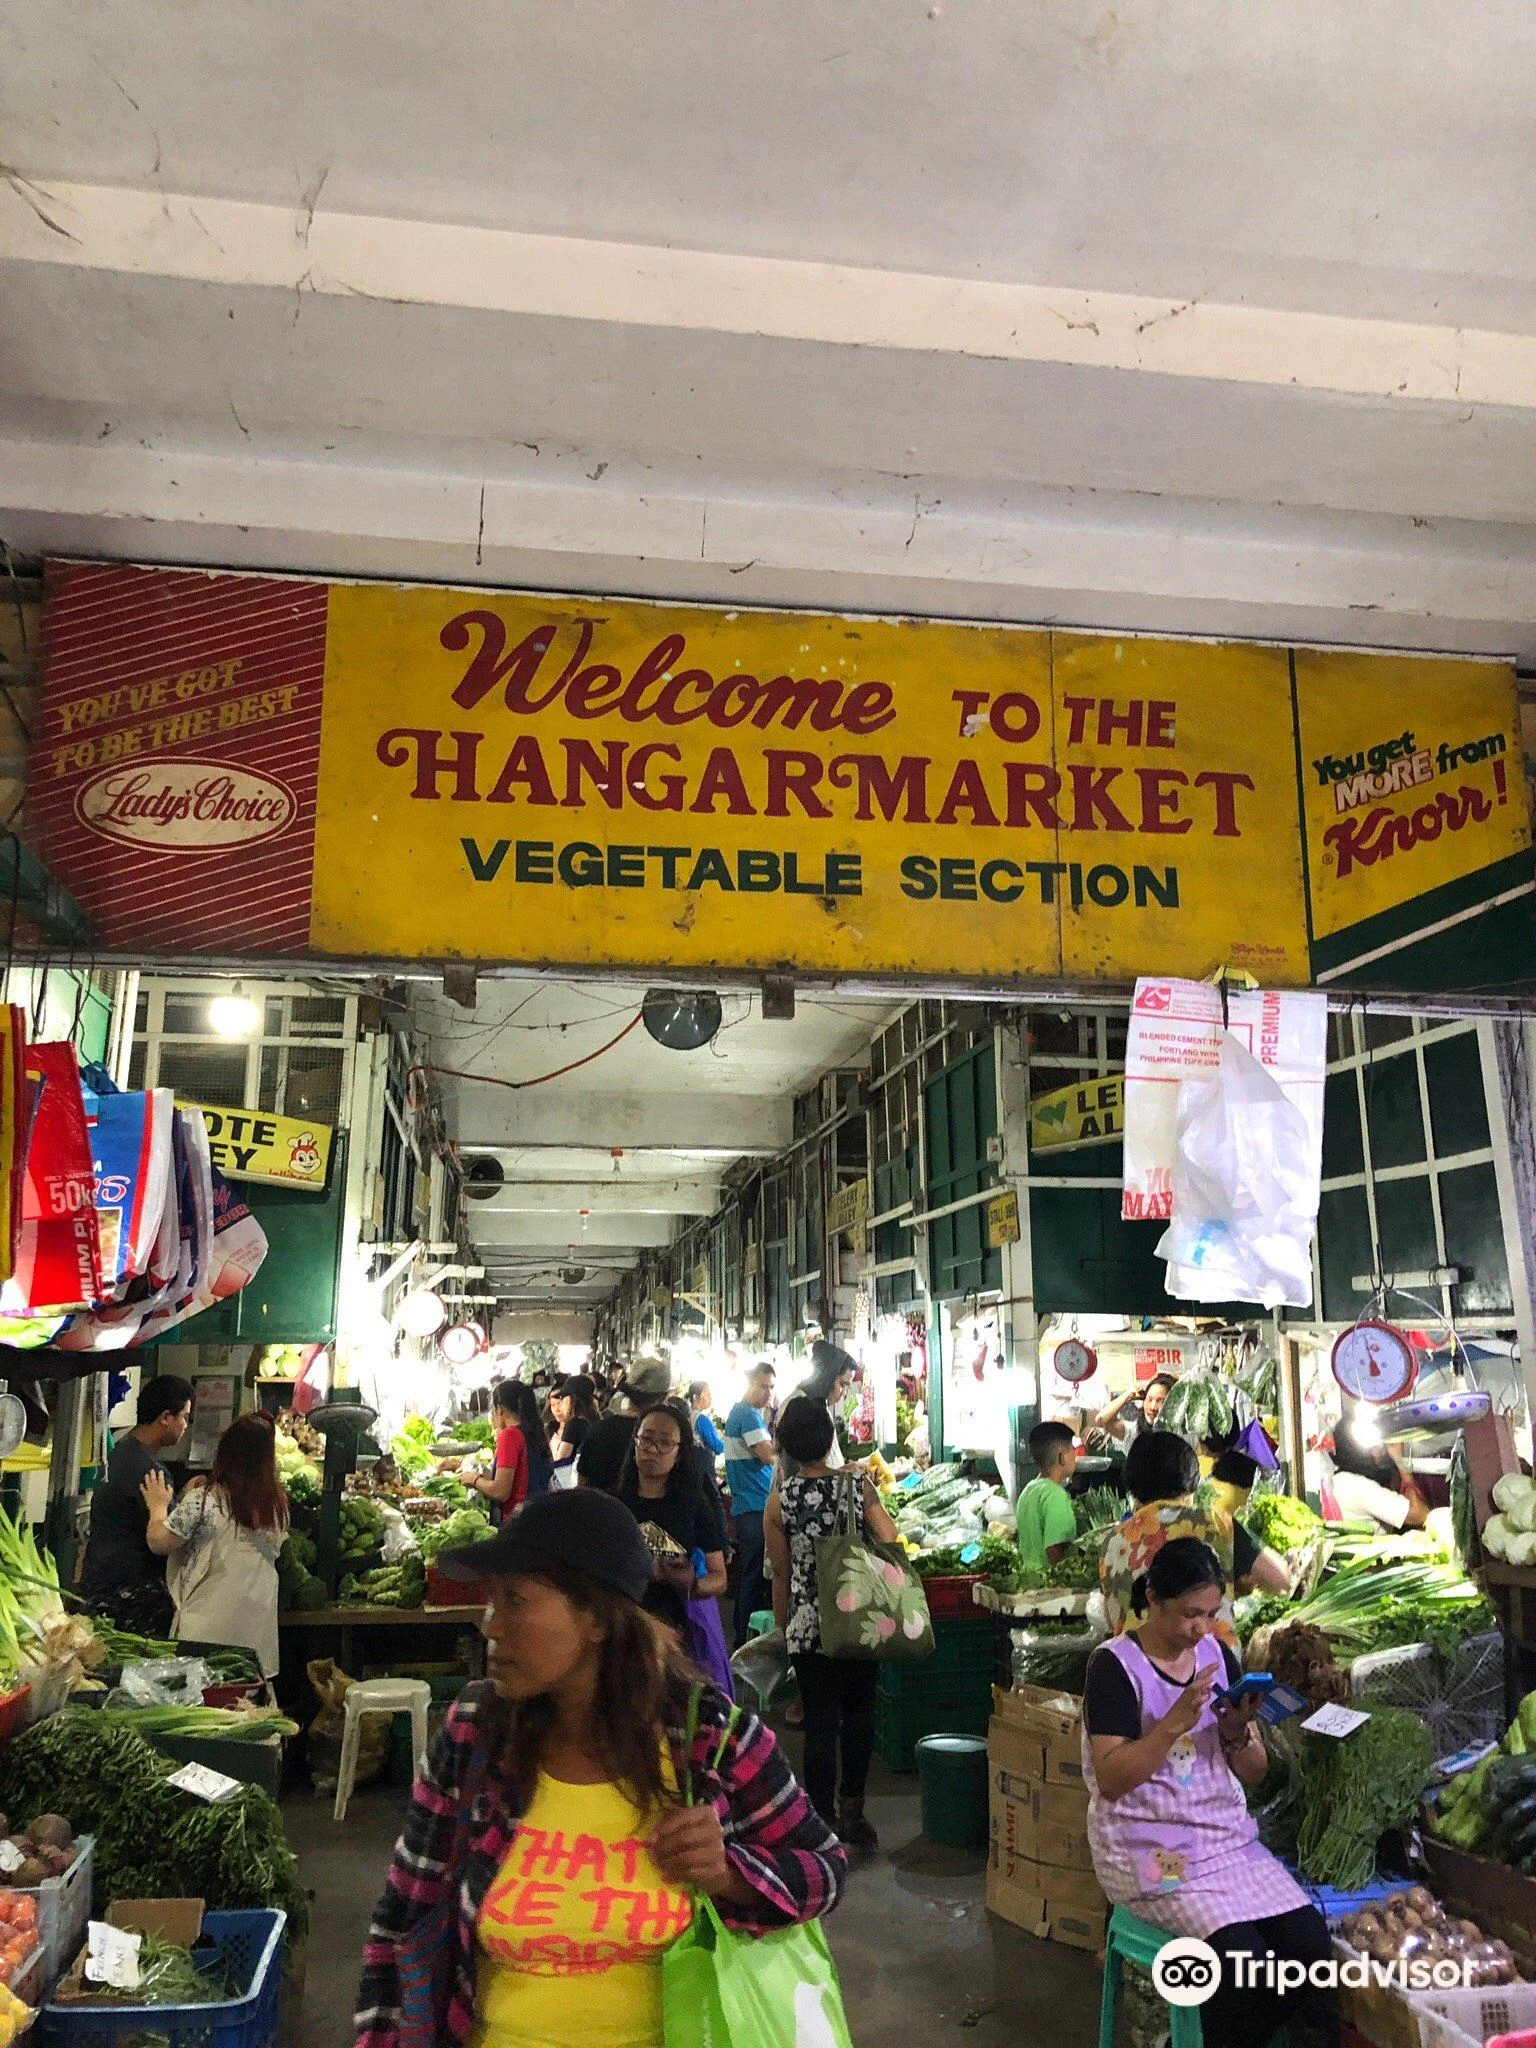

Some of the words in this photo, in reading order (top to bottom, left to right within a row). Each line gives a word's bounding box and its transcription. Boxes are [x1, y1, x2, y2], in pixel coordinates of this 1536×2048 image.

[55, 680, 168, 733] YOU'VE
[175, 659, 243, 698] GOT
[440, 608, 897, 736] Welcome
[952, 689, 1040, 744] TO
[1062, 690, 1177, 749] THE
[52, 742, 95, 777] TO
[100, 727, 143, 762] BE
[151, 708, 213, 748] THE
[217, 686, 299, 730] BEST
[1312, 755, 1365, 786] You
[1366, 730, 1416, 777] get
[91, 773, 192, 826] Lady's
[193, 776, 285, 822] Choice
[1333, 749, 1434, 815] MORE
[1436, 733, 1507, 776] from
[460, 837, 862, 896] VEGETABLE
[900, 855, 1180, 909] SECTION
[1177, 1035, 1206, 1044] CEMENT
[1261, 992, 1281, 1066] PREMIUM
[1077, 1082, 1125, 1114] LE
[1157, 1349, 1181, 1364] BIR
